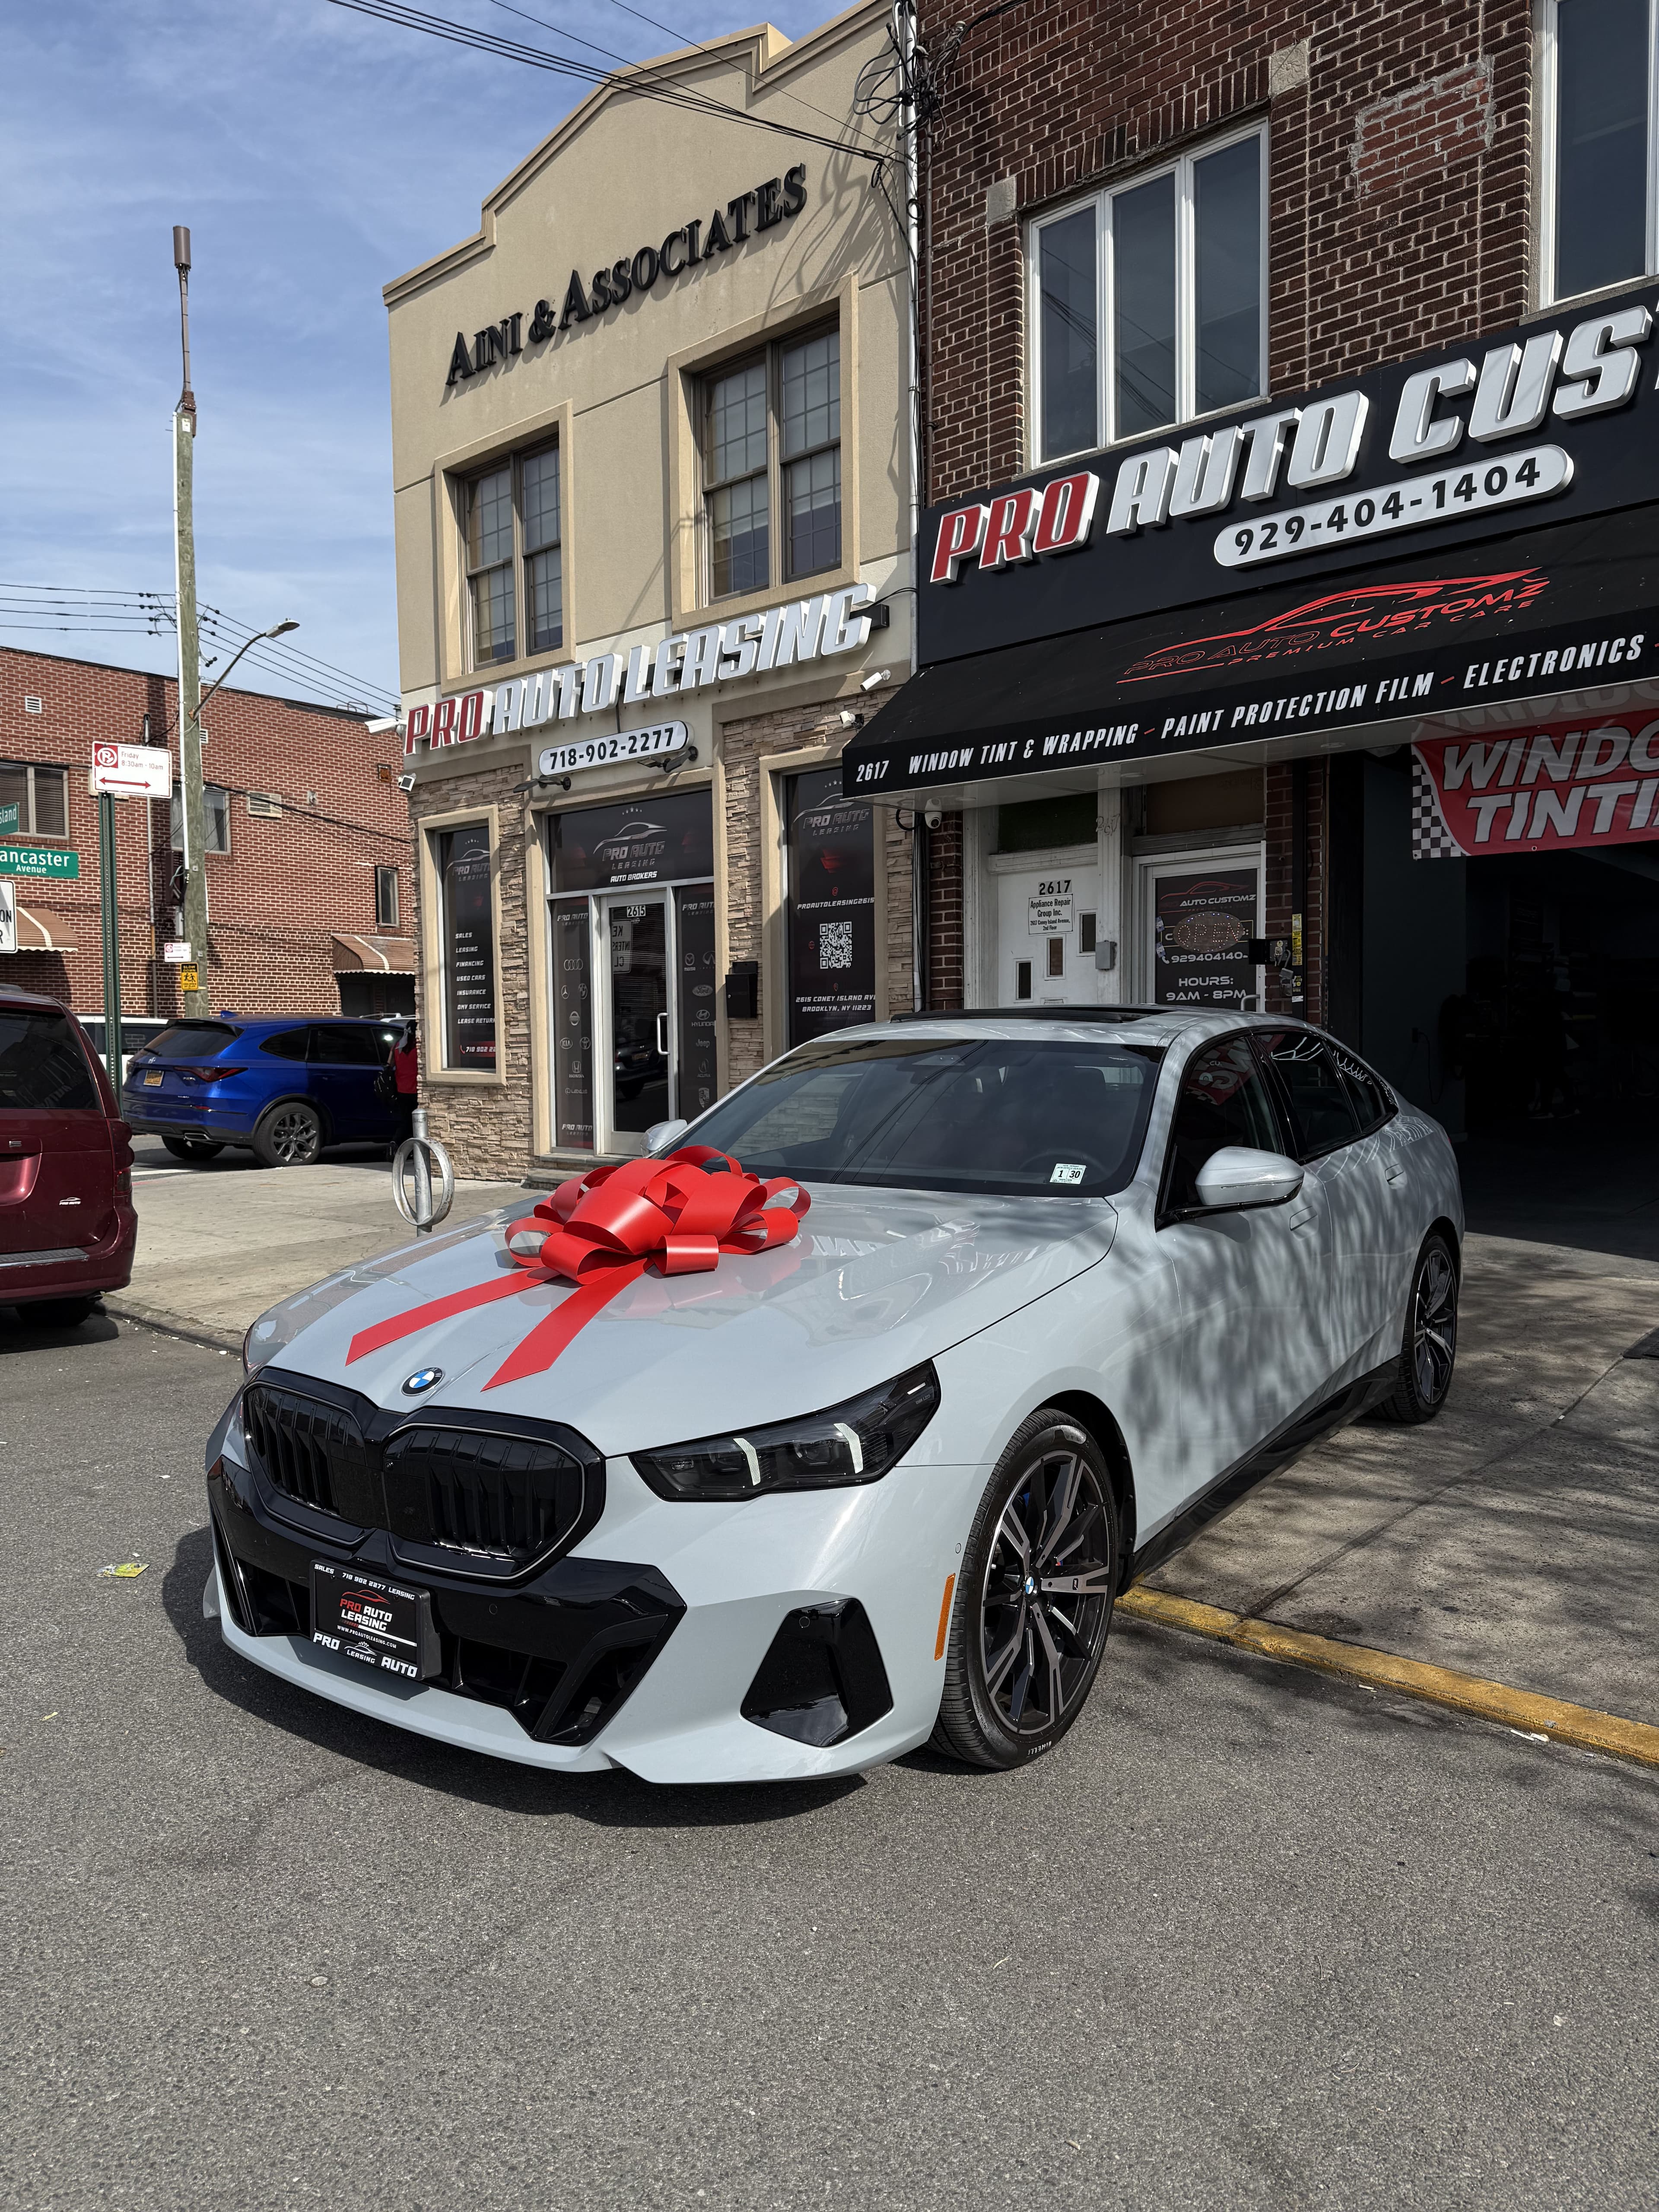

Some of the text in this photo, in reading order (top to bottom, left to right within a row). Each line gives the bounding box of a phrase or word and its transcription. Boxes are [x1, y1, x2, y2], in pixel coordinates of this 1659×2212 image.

[445, 163, 807, 386] AINI & ASSOCIATES
[930, 299, 1659, 585] PRO AUTO CUS
[1235, 458, 1540, 556] 929-404-1404
[1124, 581, 1550, 674] PRO AUTO CUSTOMZ
[1228, 600, 1535, 665] PREMIUM CAR CARE
[404, 583, 877, 756] PRO AUTO LEASING
[856, 760, 889, 782] 2617
[908, 748, 974, 774] WINDOW
[980, 741, 1018, 765] TINT
[1023, 739, 1034, 759] &
[1042, 724, 1139, 756] WRAPPING
[1161, 709, 1224, 739] PAINT
[1232, 688, 1365, 728] PROTECTION
[1375, 672, 1434, 705] FILM
[1463, 634, 1644, 689] ELECTRONICS
[121, 751, 139, 760] Friday
[550, 727, 673, 769] 718-902-2277
[1465, 779, 1659, 844] TINTI
[803, 814, 831, 829] PRO
[813, 824, 859, 836] LEASING
[602, 841, 665, 861] PRO AUTO
[16, 864, 47, 874] Avenue
[452, 865, 470, 875] PRO
[612, 858, 655, 870] LEASING
[627, 871, 658, 880] BROKERS
[1039, 880, 1071, 895] 2617
[682, 903, 698, 911] PRO
[797, 897, 874, 909] PROAUTOLEASING2615
[1030, 897, 1071, 909] Appliance Repair
[1180, 894, 1256, 907] AUTO CUSTOMZ
[627, 906, 645, 917] 2615
[1178, 922, 1240, 943] OPEN
[1171, 951, 1248, 963] 929404140
[1179, 976, 1234, 987] HOURS:
[1166, 992, 1200, 1001] 9AM
[1212, 989, 1246, 999] 8PM
[696, 1039, 710, 1048] Jeep
[314, 1564, 334, 1574] SALES
[354, 1576, 367, 1585] 902
[369, 1581, 386, 1590] 2277
[388, 1587, 415, 1600] LEASING
[340, 1599, 393, 1622] PRO AUTO
[341, 1609, 388, 1631] LEASING
[337, 1625, 397, 1649] WWW.PROAUTOLEASING.COM
[313, 1632, 418, 1678] PRO LEASING AUTO
